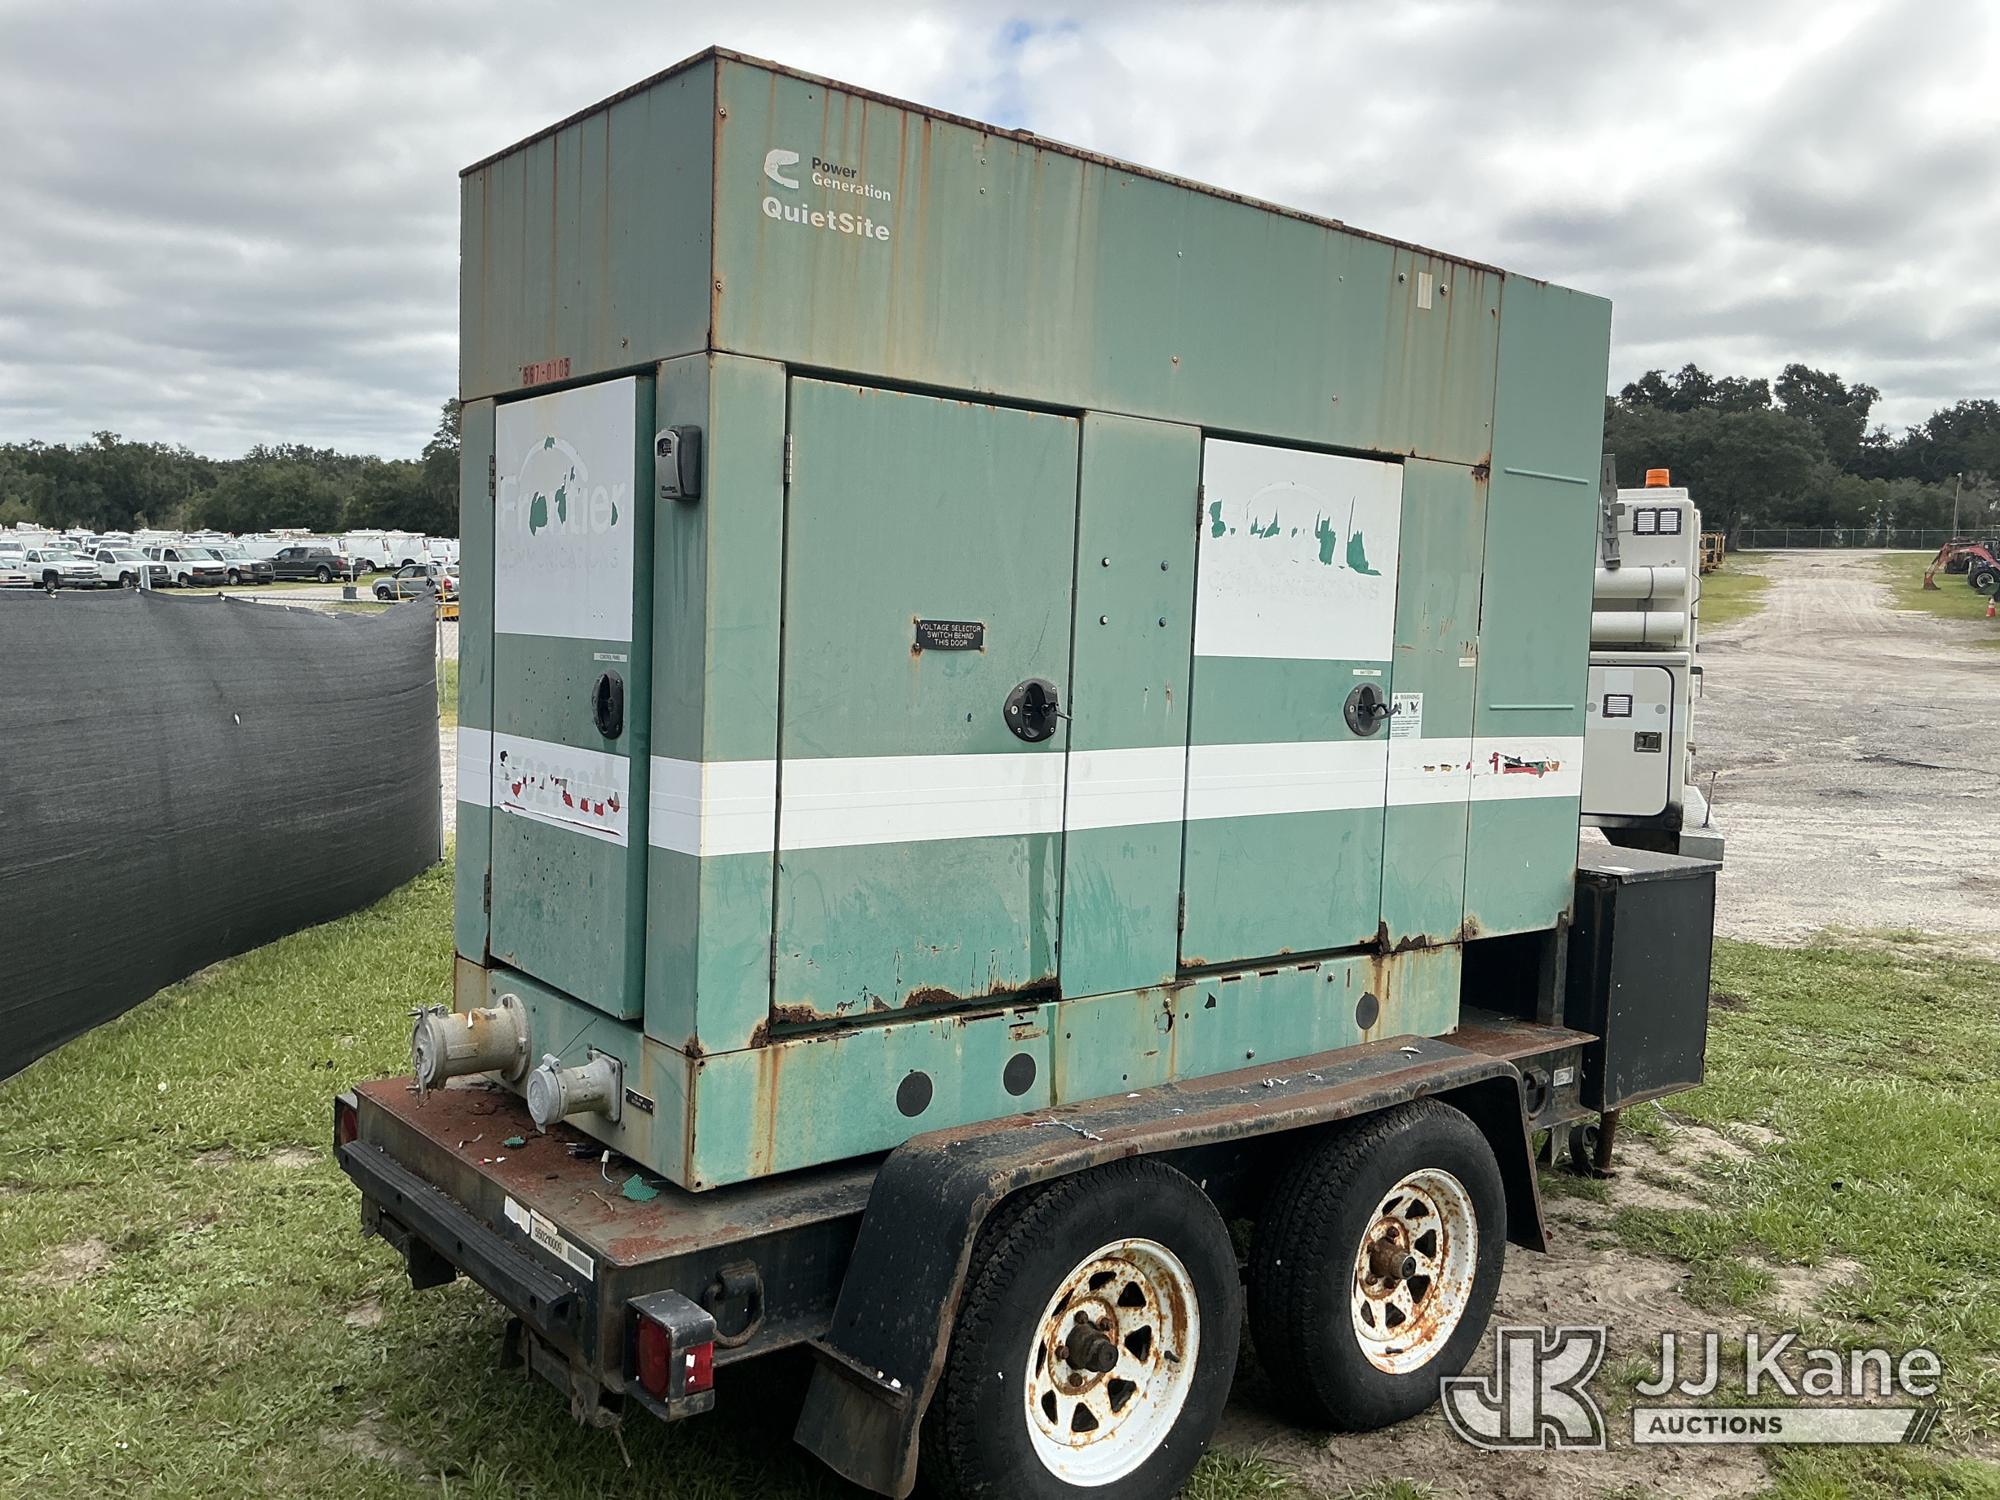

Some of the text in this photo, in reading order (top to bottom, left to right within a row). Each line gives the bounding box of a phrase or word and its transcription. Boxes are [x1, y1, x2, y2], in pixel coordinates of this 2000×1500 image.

[811, 157, 857, 178] Power
[811, 172, 891, 201] Generation
[762, 196, 890, 241] QuietSite
[920, 623, 981, 632] VOLTAGE SELECTOR
[927, 631, 974, 640] SWITCH BEHIND
